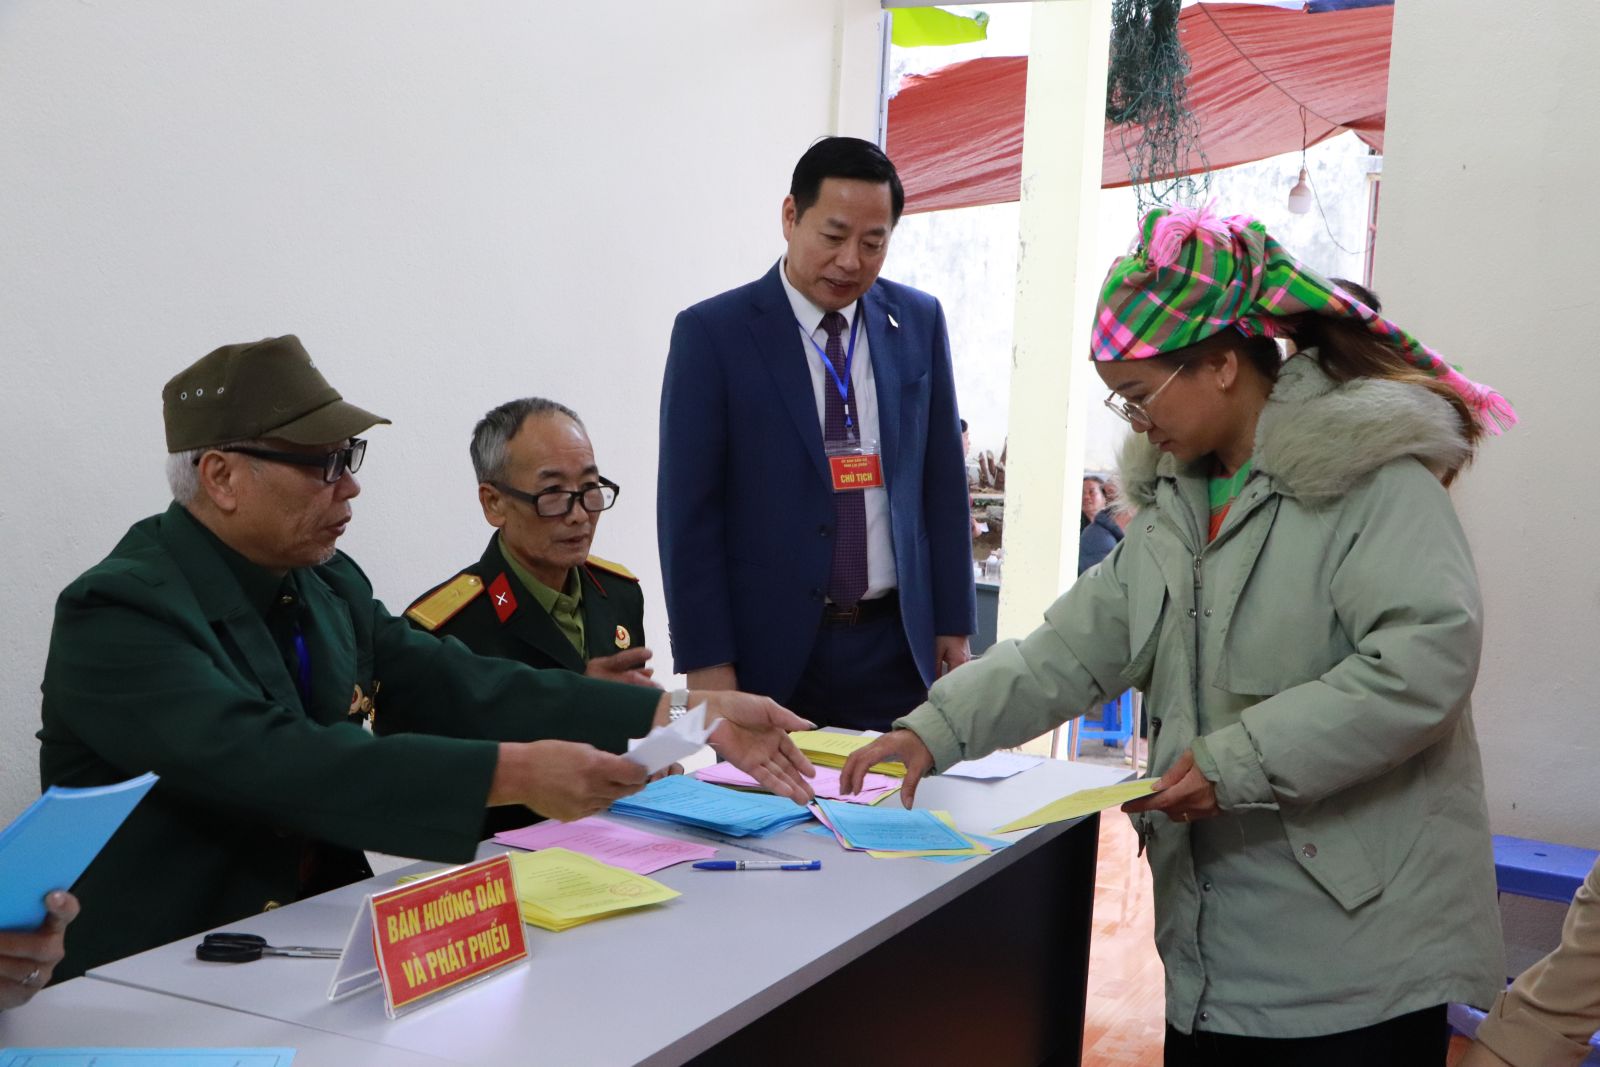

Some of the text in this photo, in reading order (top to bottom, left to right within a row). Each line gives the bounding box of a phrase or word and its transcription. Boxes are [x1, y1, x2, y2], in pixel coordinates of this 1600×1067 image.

[856, 472, 873, 484] TỊCH
[387, 906, 420, 944] BÀN
[423, 891, 475, 931] HƯỚNG
[475, 872, 507, 907] DẪN
[401, 918, 510, 988] VÀ PHÁT PHIẾU
